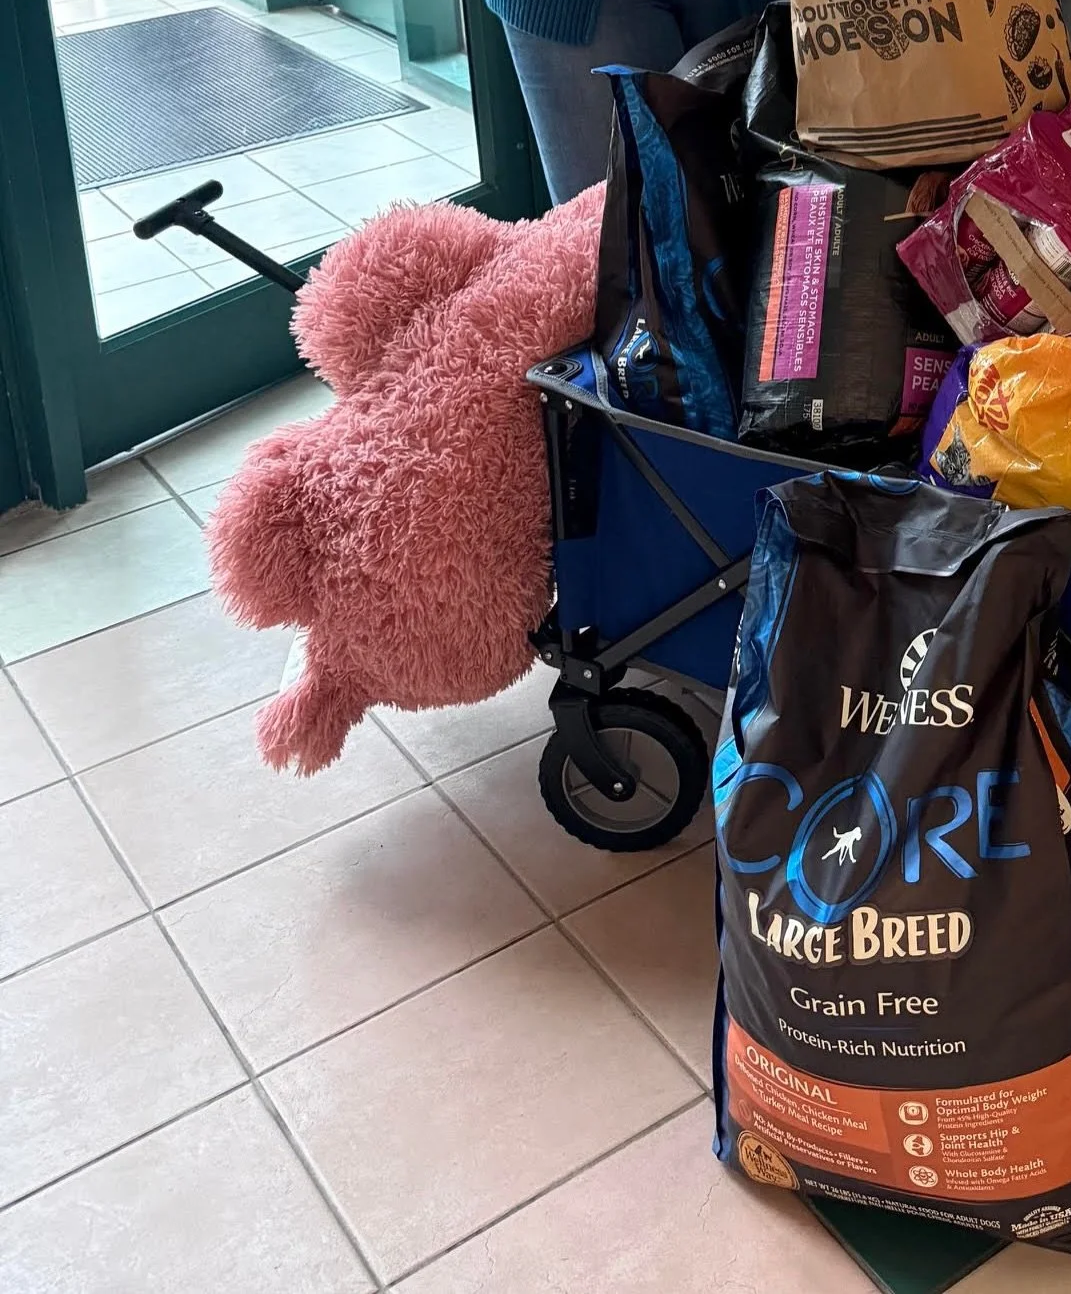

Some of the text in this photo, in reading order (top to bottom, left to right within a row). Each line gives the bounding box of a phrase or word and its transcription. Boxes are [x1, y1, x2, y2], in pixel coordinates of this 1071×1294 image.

[796, 15, 894, 66] MOE'S
[902, 1, 963, 43] ON
[815, 190, 828, 246] SENSITIVE
[832, 223, 842, 256] ADULTE
[793, 190, 819, 373] PEAUX ET ESTOMACS SENSIBLES
[812, 249, 823, 275] SKIN
[805, 288, 819, 344] STOMACH
[915, 331, 945, 344] ADULT
[839, 683, 975, 736] WENESS
[716, 761, 1031, 924] CORE
[747, 891, 972, 965] LARGE BREED
[790, 986, 939, 1017] Grain Free
[778, 1017, 966, 1058] Protein-Rich Nutrition
[746, 1045, 838, 1105] ORIGINAL
[758, 1090, 843, 1137] Turkey Meal Recipe
[765, 1082, 868, 1131] Chicken, Chicken Meal
[935, 1089, 1015, 1107] Formulated for
[937, 1088, 1048, 1117] Optimal Body Weight
[753, 1122, 783, 1143] Artificial
[784, 1139, 835, 1164] Preservatives
[847, 1161, 877, 1174] Flavors
[767, 1121, 785, 1137] Meat
[939, 1126, 1021, 1143] Supports Hip &
[941, 1138, 1004, 1151] Joint Health
[945, 1158, 1045, 1179] Whole Body Health
[955, 1213, 978, 1224] ADULT
[979, 1218, 1001, 1229] DOGS
